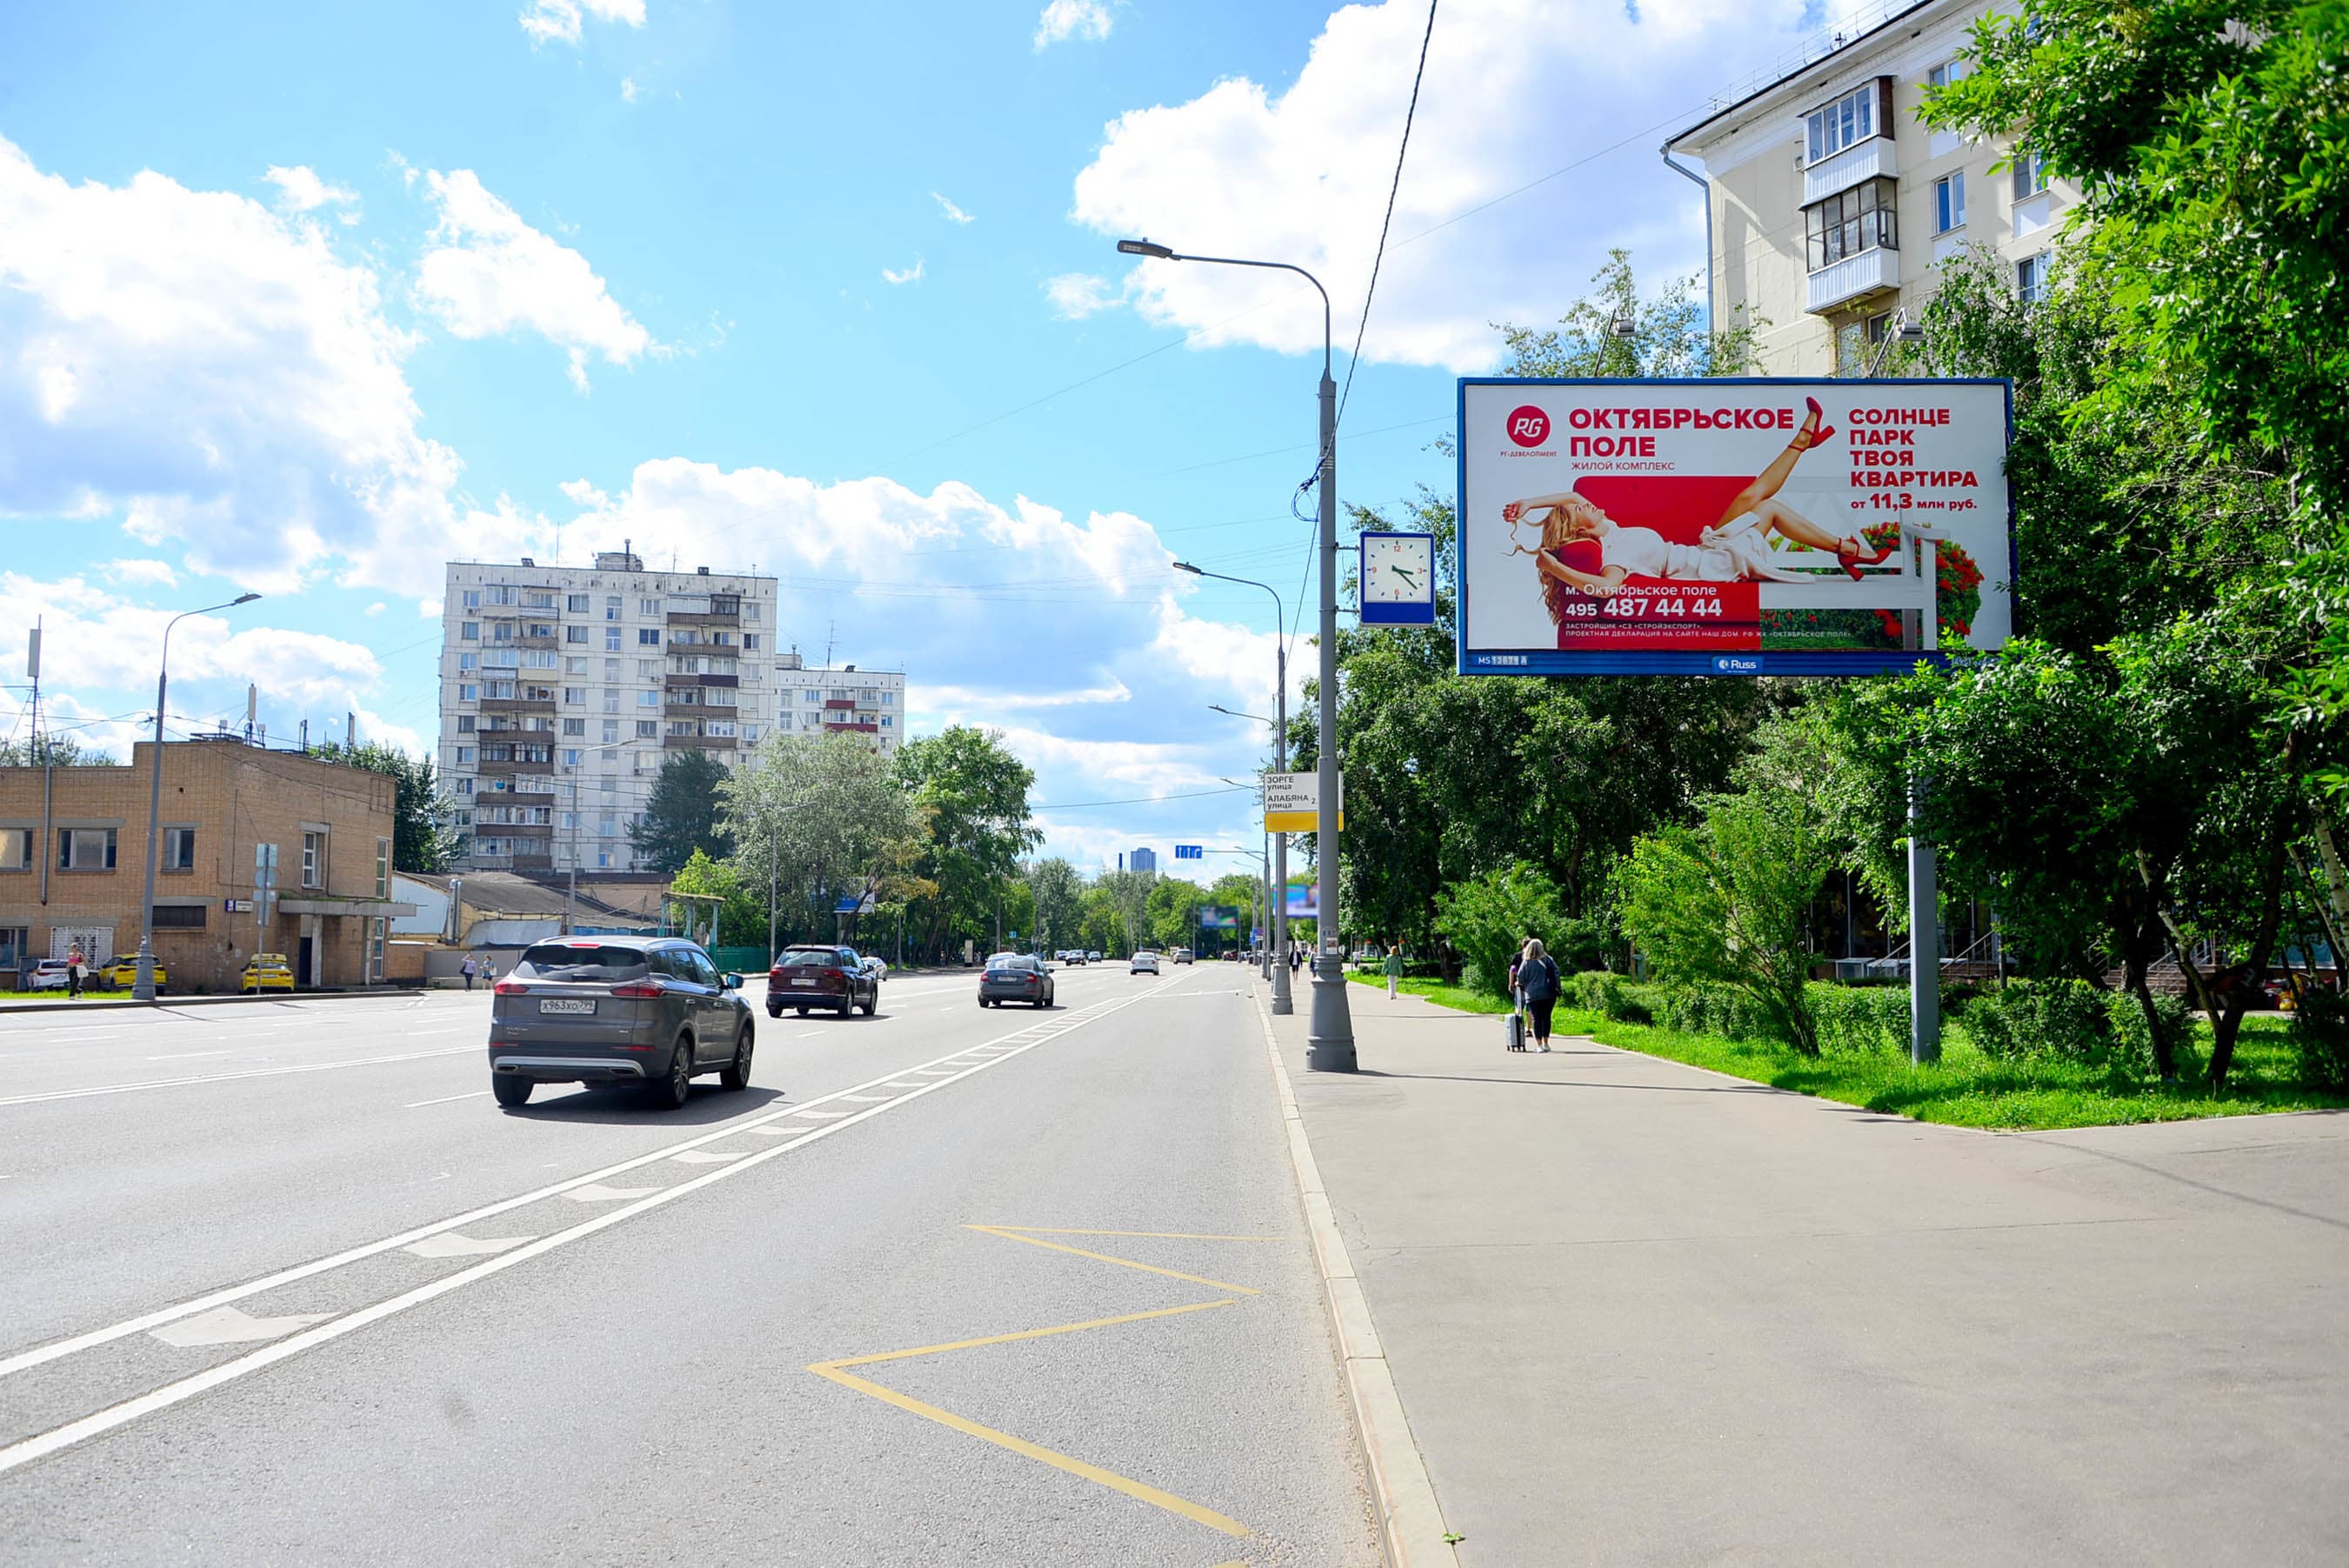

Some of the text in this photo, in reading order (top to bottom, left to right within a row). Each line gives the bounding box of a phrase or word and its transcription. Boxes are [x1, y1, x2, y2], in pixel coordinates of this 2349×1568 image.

[1569, 408, 1793, 430] ОКТЯБРЬСКОЕ
[1849, 409, 1950, 427] СОЛНЦЕ
[1850, 430, 1915, 445] ПАРК
[1571, 437, 1655, 457] ПОЛЕ
[1572, 462, 1675, 470] ЖИЛОЙ КОМПЛЕКС
[1850, 450, 1913, 466] ТВОЯ
[1851, 471, 1979, 487] КВАРТИРА
[1870, 492, 1912, 511] 11,3
[1949, 498, 1978, 511] руб.
[1565, 584, 1717, 597] м. Октябрьское поле
[1565, 598, 1723, 617] 495 487 44 44
[1732, 659, 1757, 669] Russ
